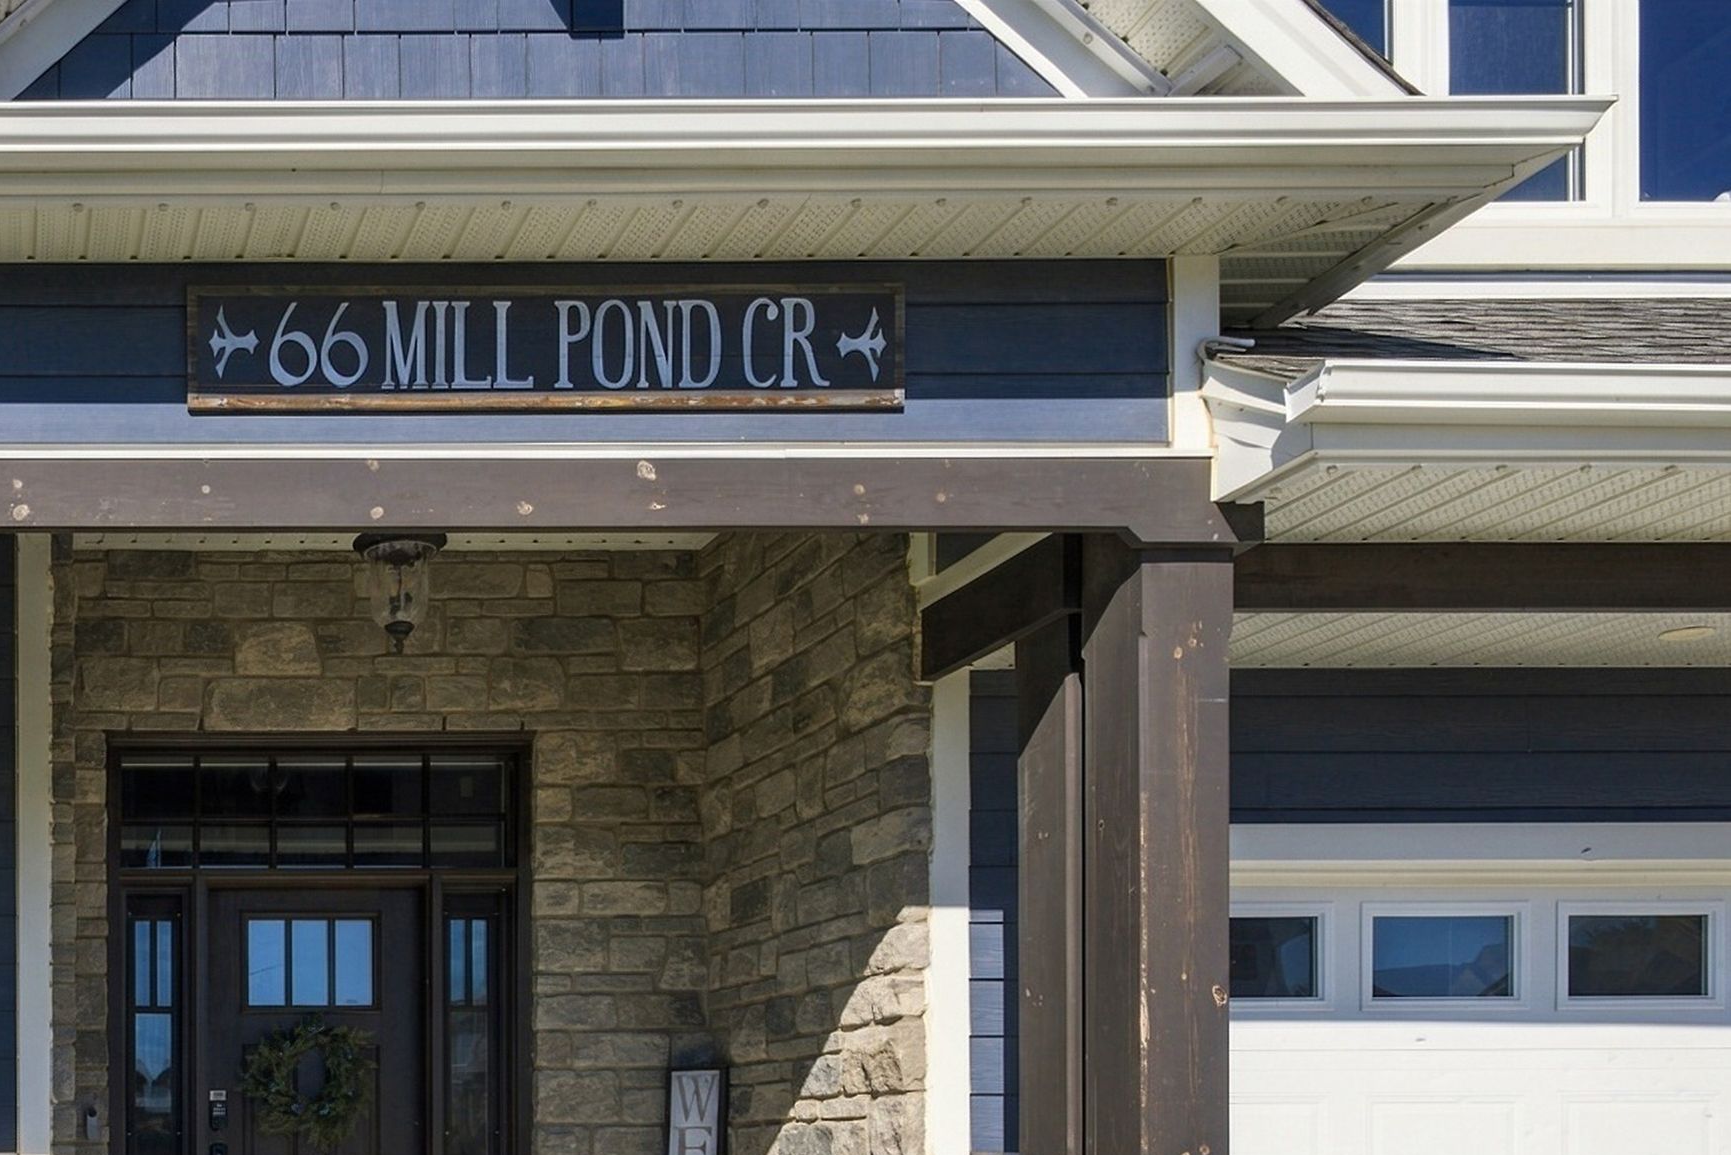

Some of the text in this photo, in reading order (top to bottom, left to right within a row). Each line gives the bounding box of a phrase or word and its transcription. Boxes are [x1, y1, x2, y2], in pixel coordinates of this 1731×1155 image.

[269, 297, 831, 389] 66 MILL POND CR
